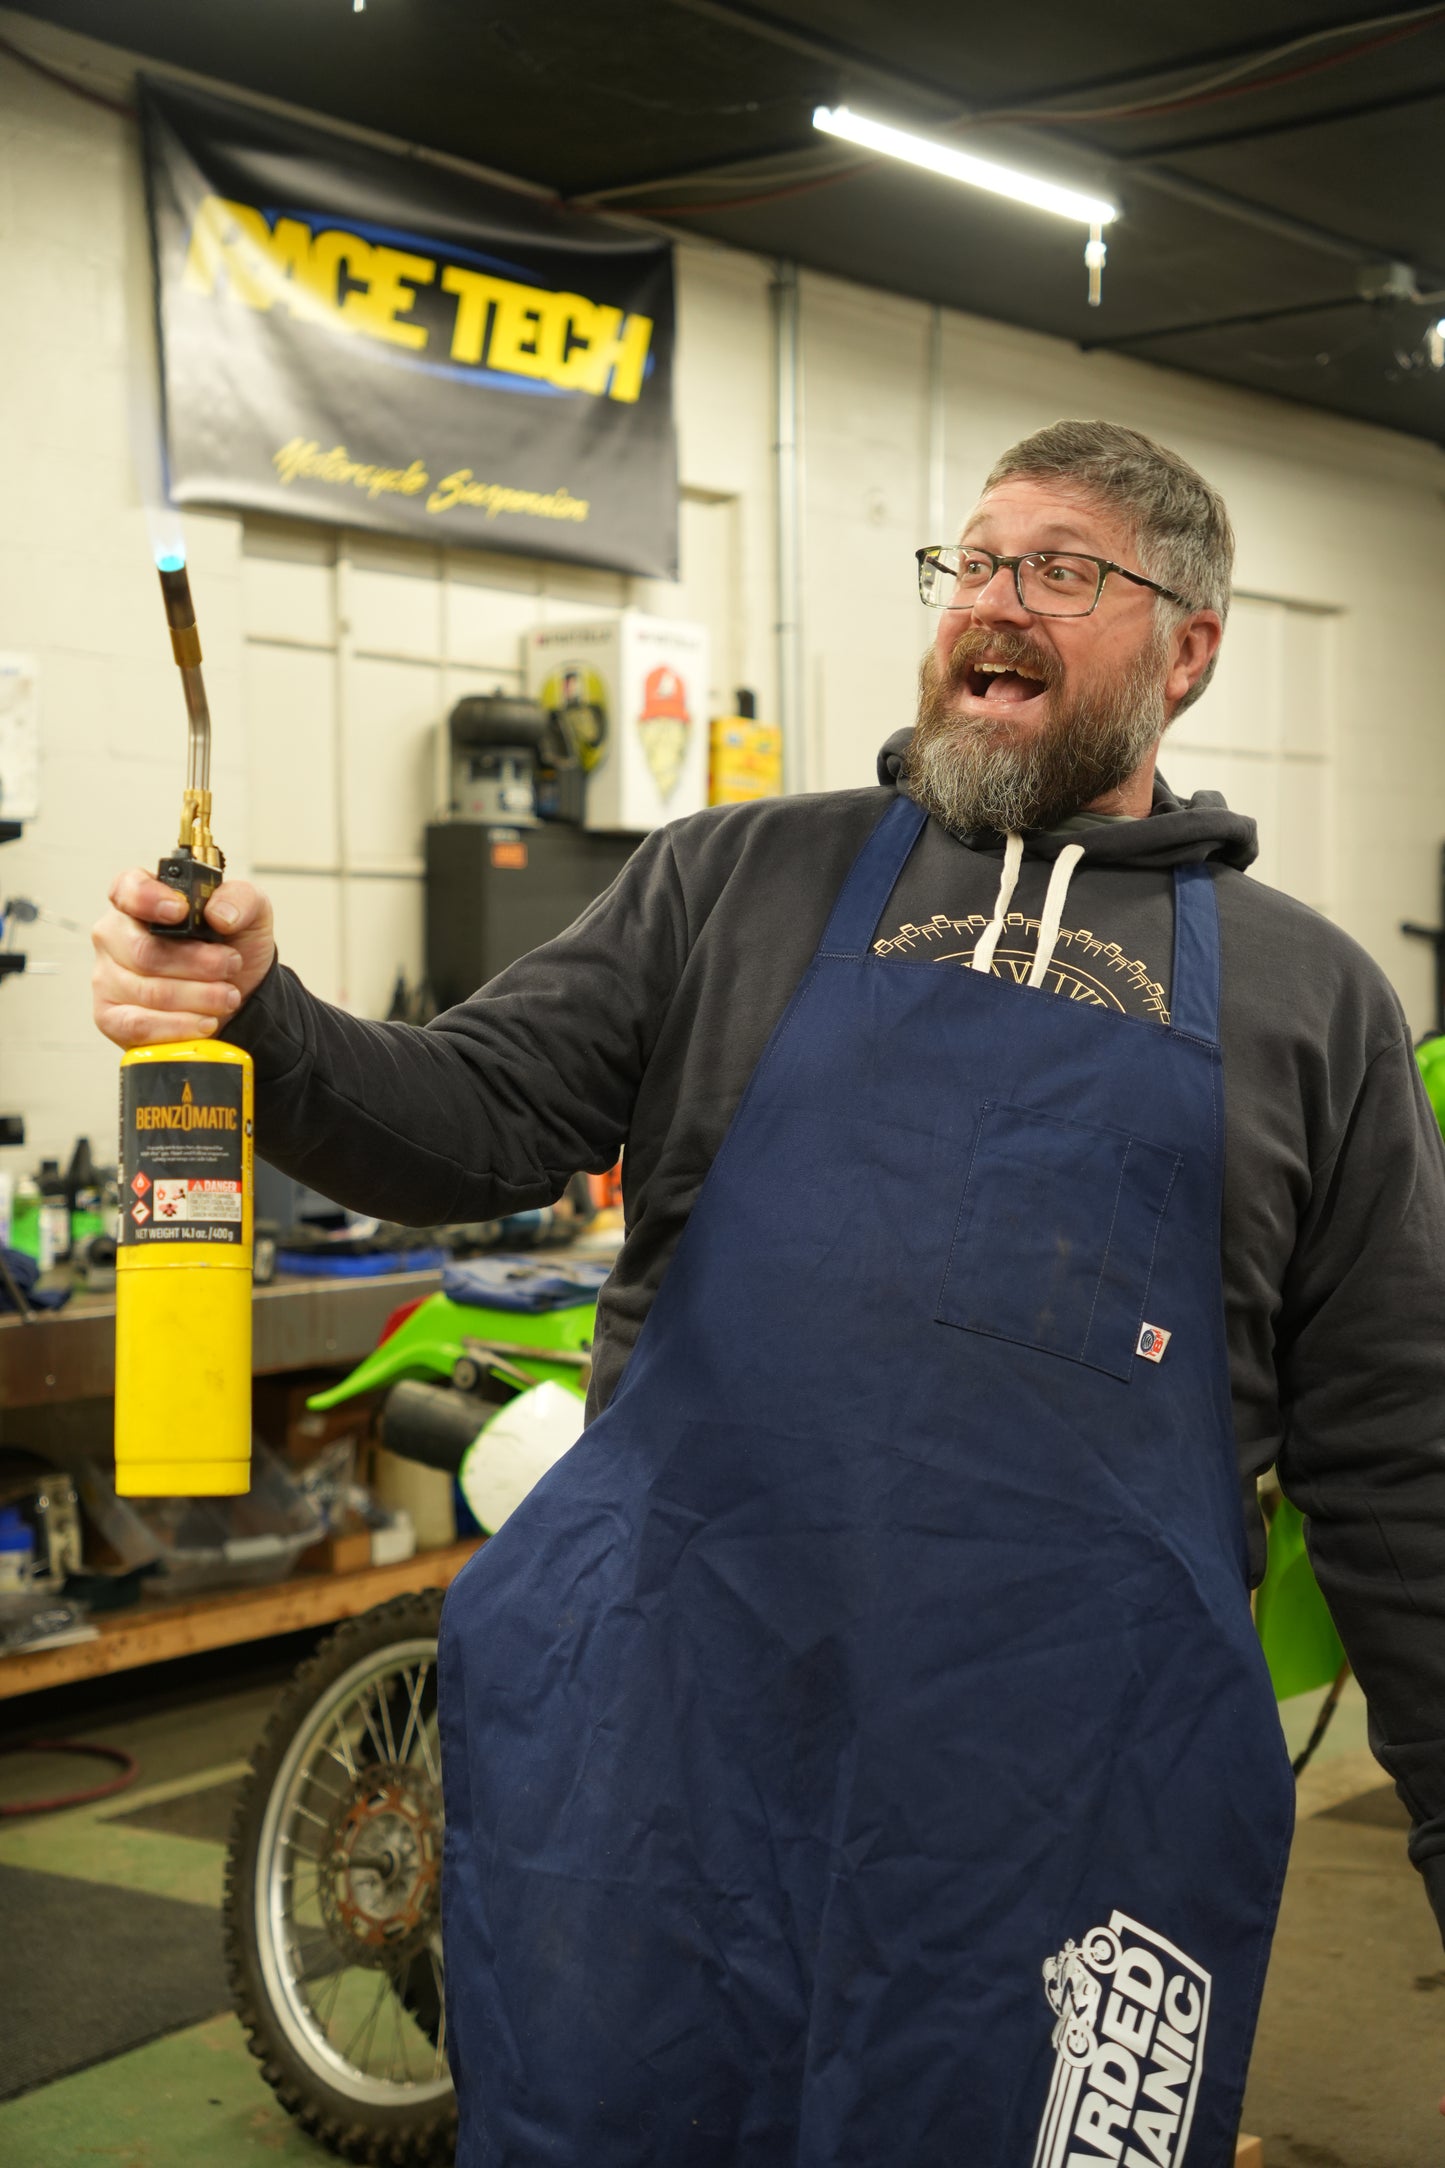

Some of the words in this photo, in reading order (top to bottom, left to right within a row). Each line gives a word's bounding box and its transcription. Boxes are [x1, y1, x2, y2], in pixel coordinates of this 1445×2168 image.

[182, 195, 436, 351] RACE
[441, 265, 653, 404] TECH
[272, 436, 429, 500] Motorcycle
[135, 1103, 238, 1131] BERNZOMATIC
[204, 1180, 237, 1193] DANGER
[135, 1228, 148, 1240] NET
[148, 1227, 179, 1240] WEIGHT
[1067, 1947, 1165, 2168] RDED
[1123, 1974, 1201, 2168] ANIC
